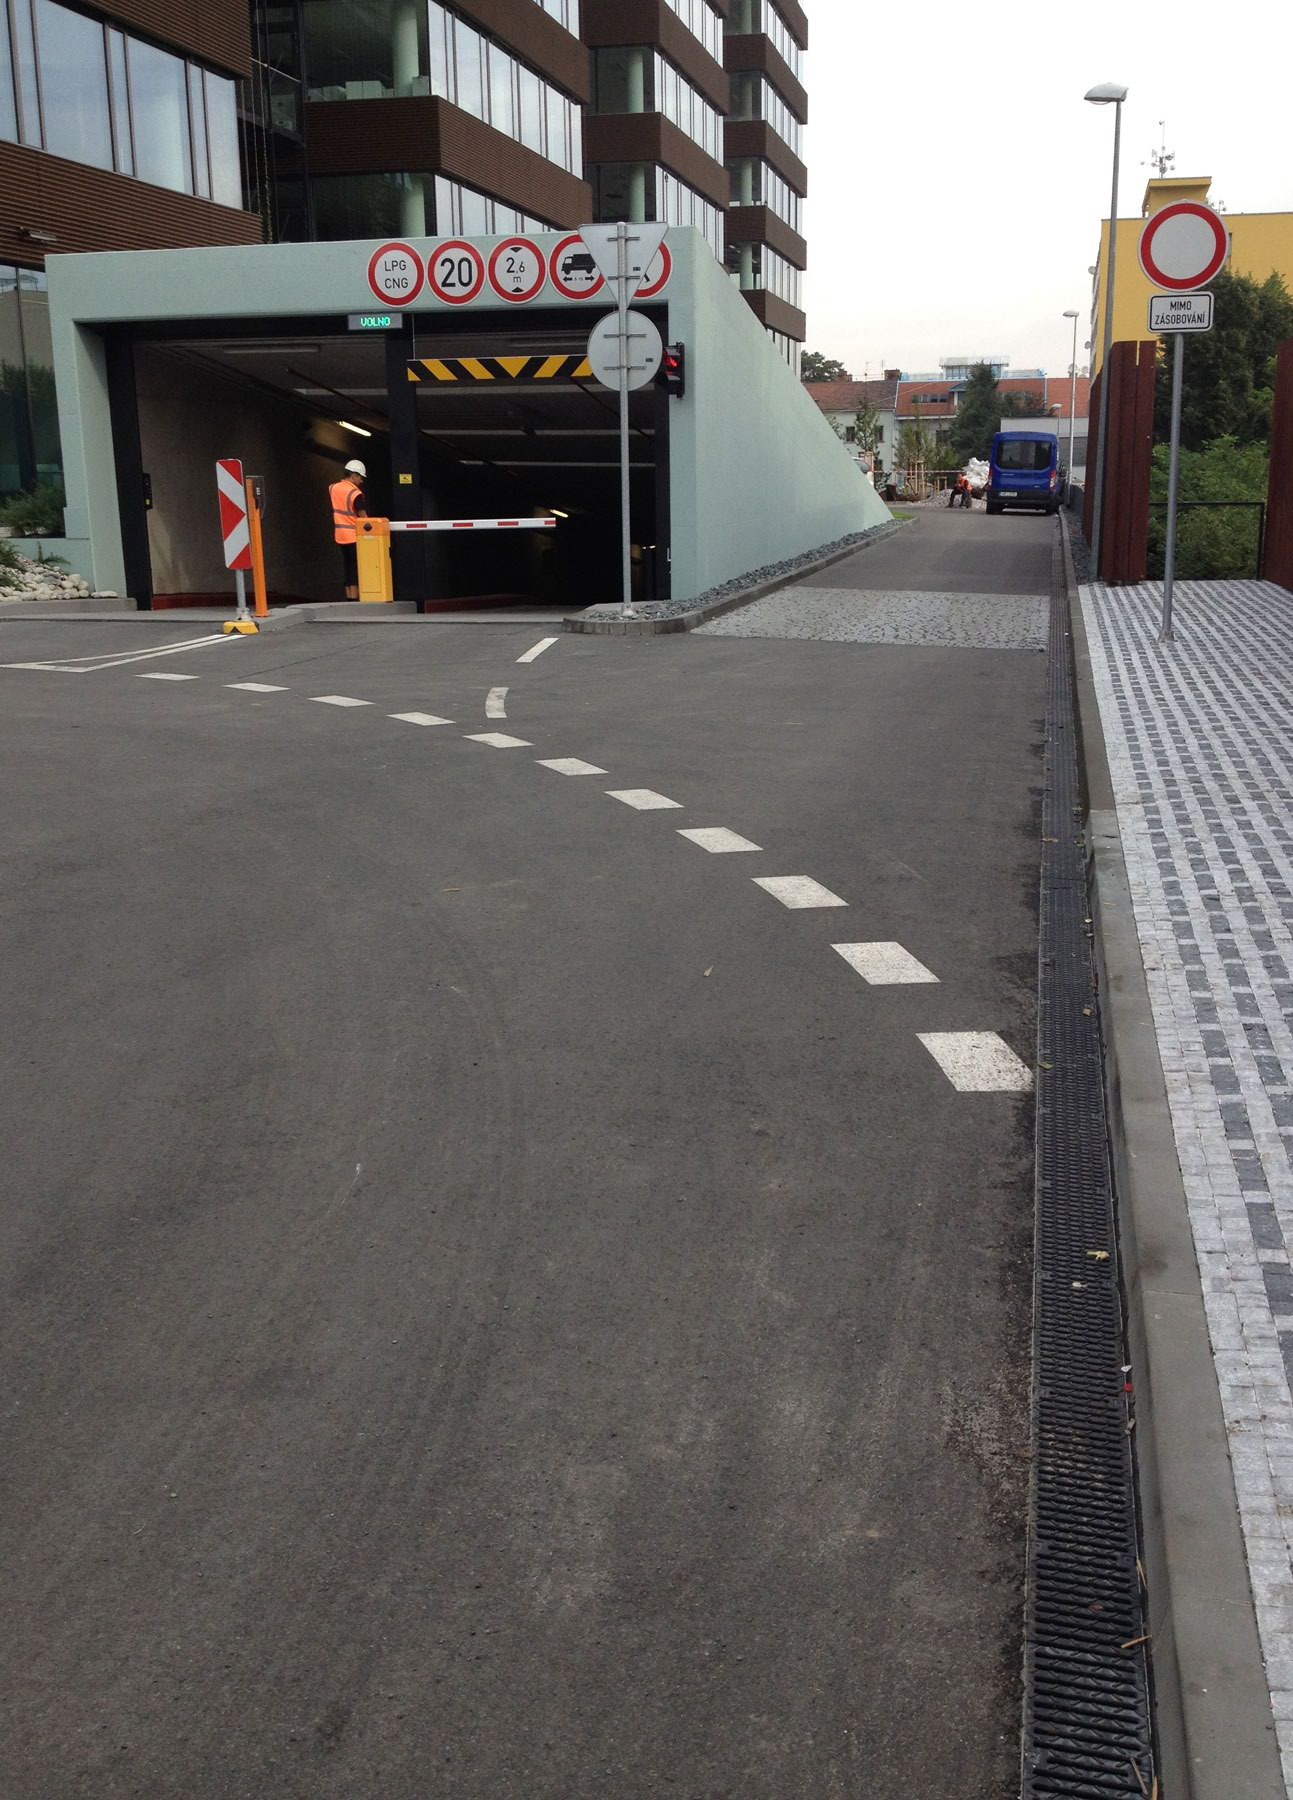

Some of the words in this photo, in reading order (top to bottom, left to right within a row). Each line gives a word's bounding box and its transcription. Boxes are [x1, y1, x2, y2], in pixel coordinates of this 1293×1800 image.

[384, 259, 407, 272] LPG
[440, 257, 473, 288] 20
[384, 277, 409, 289] CNG
[1170, 300, 1192, 311] MIMO
[360, 316, 391, 327] VOLNO
[1155, 311, 1206, 325] ZÁSOBOVÁNÍ
